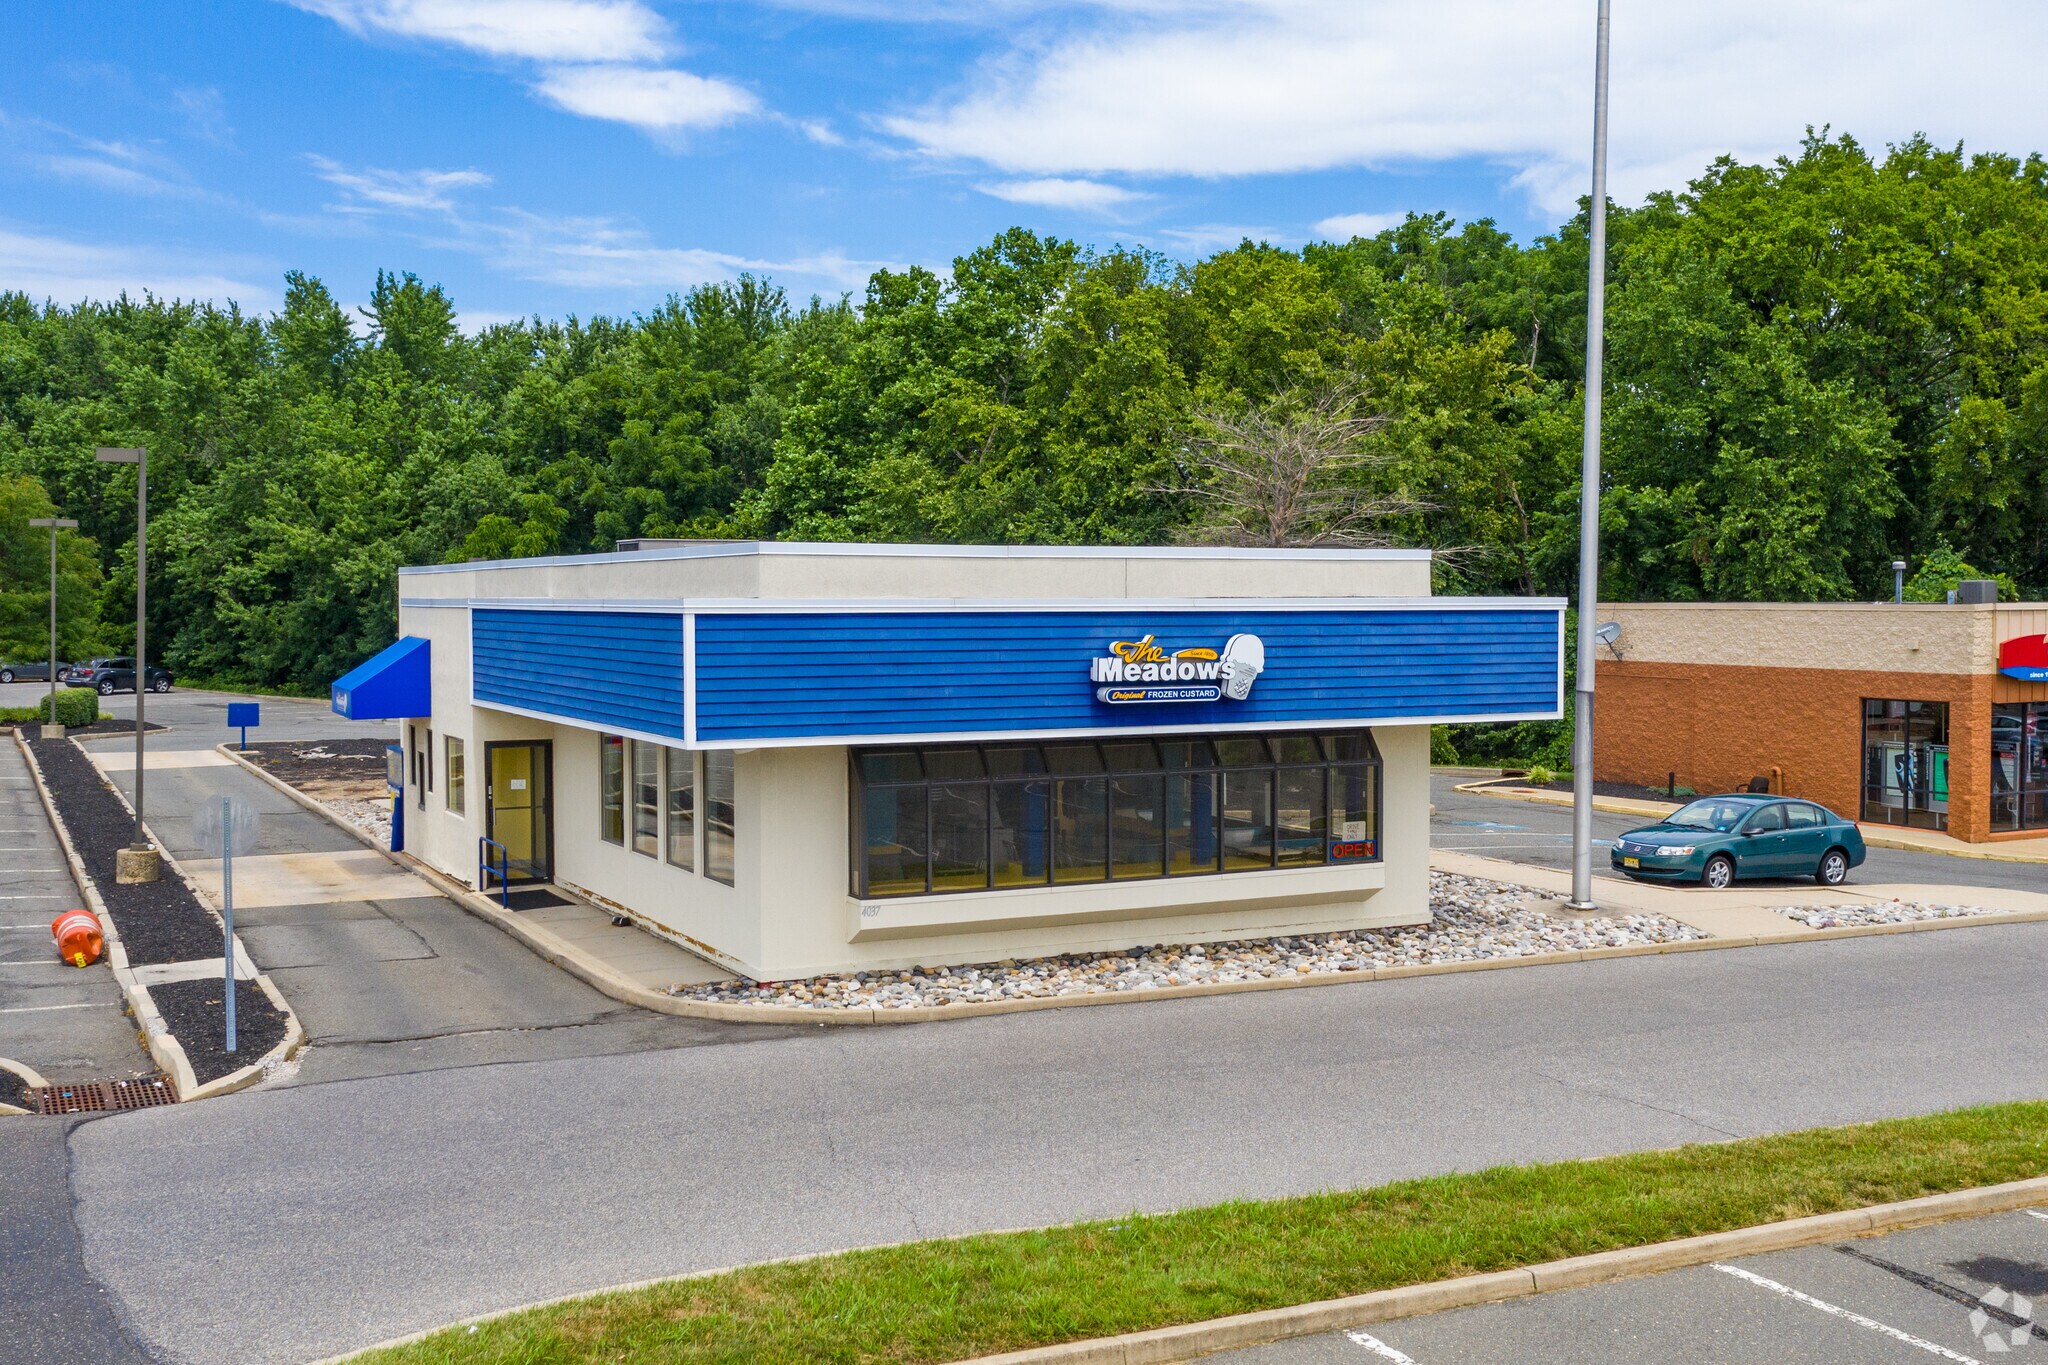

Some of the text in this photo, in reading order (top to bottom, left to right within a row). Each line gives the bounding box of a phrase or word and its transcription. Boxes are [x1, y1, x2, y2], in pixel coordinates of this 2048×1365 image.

[1112, 635, 1171, 663] The
[1097, 657, 1236, 682] Meadows
[1112, 689, 1215, 700] Original FROZEN CUSTARD
[1332, 843, 1374, 859] OPEN
[861, 905, 881, 917] 4037
